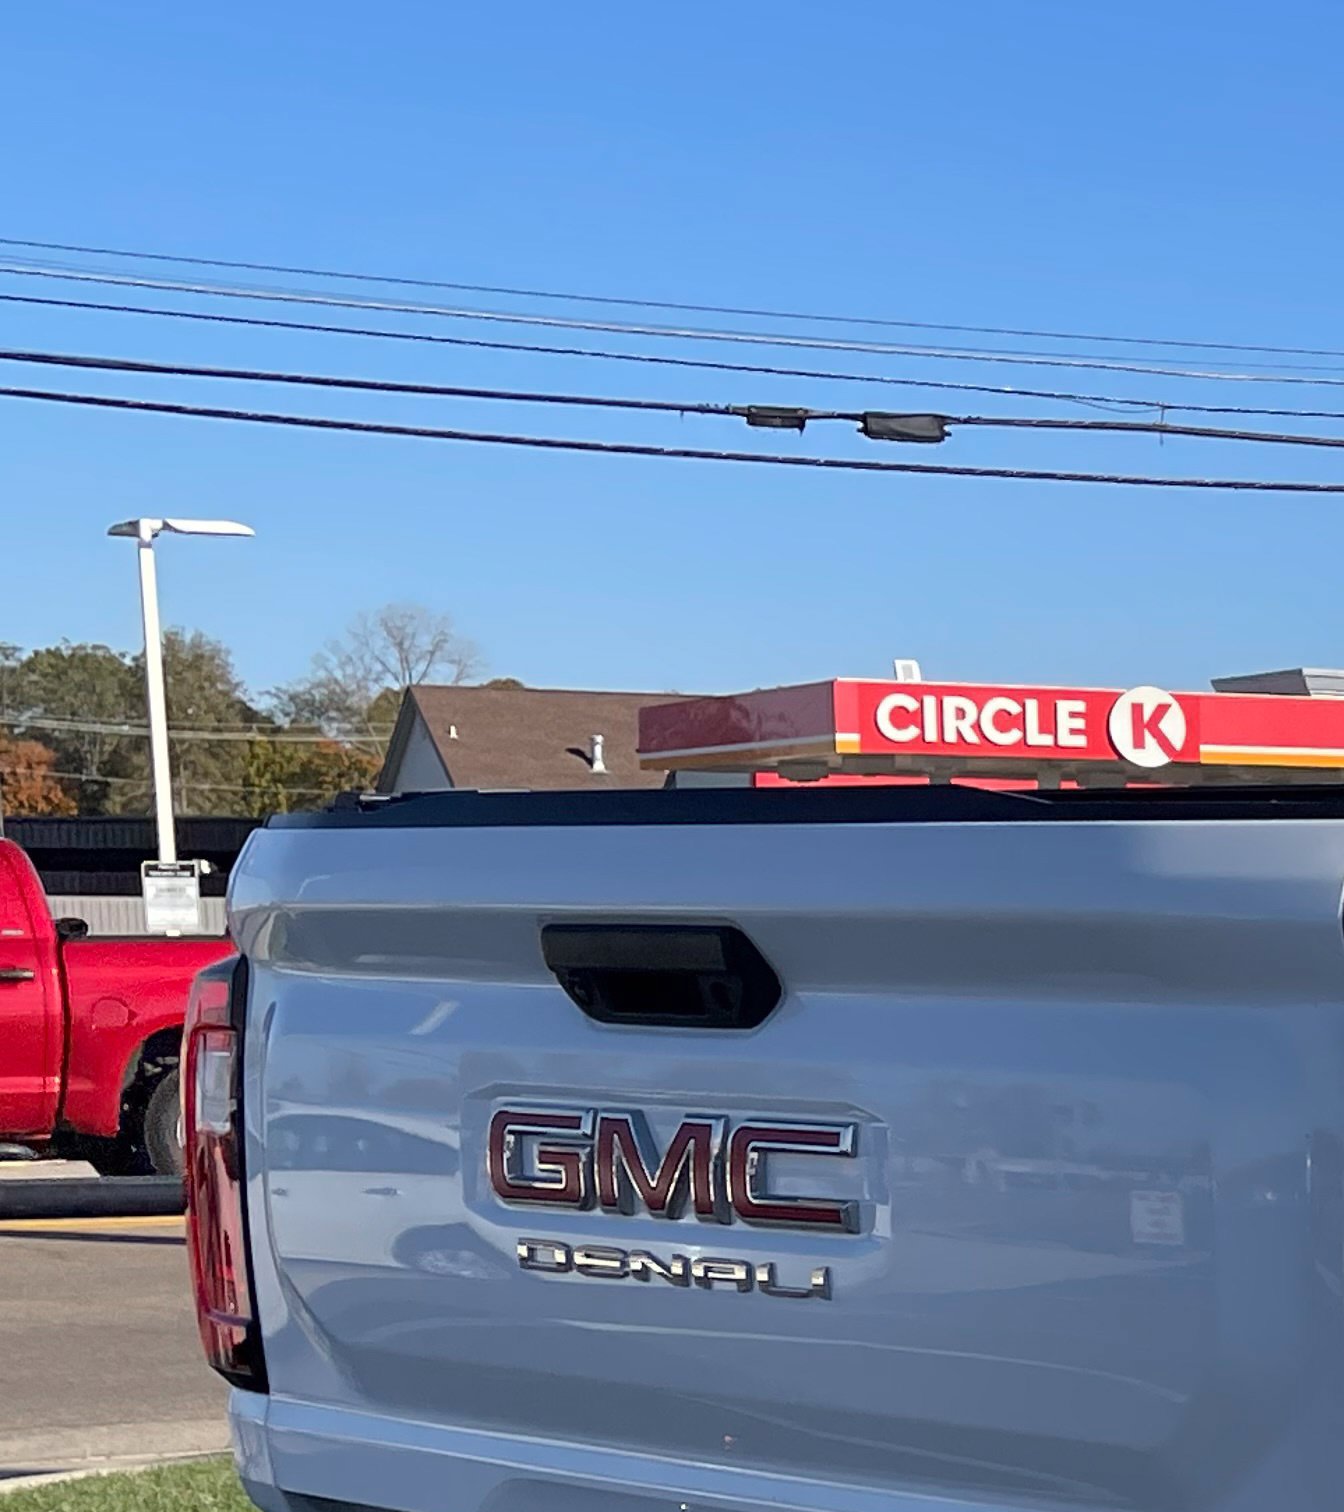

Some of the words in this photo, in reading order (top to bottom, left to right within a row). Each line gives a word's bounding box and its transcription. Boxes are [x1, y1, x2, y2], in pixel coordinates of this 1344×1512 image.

[876, 693, 1088, 749] CIRCLE
[1130, 701, 1182, 761] K
[487, 1107, 862, 1235] GMC
[516, 1237, 833, 1301] DENALI
